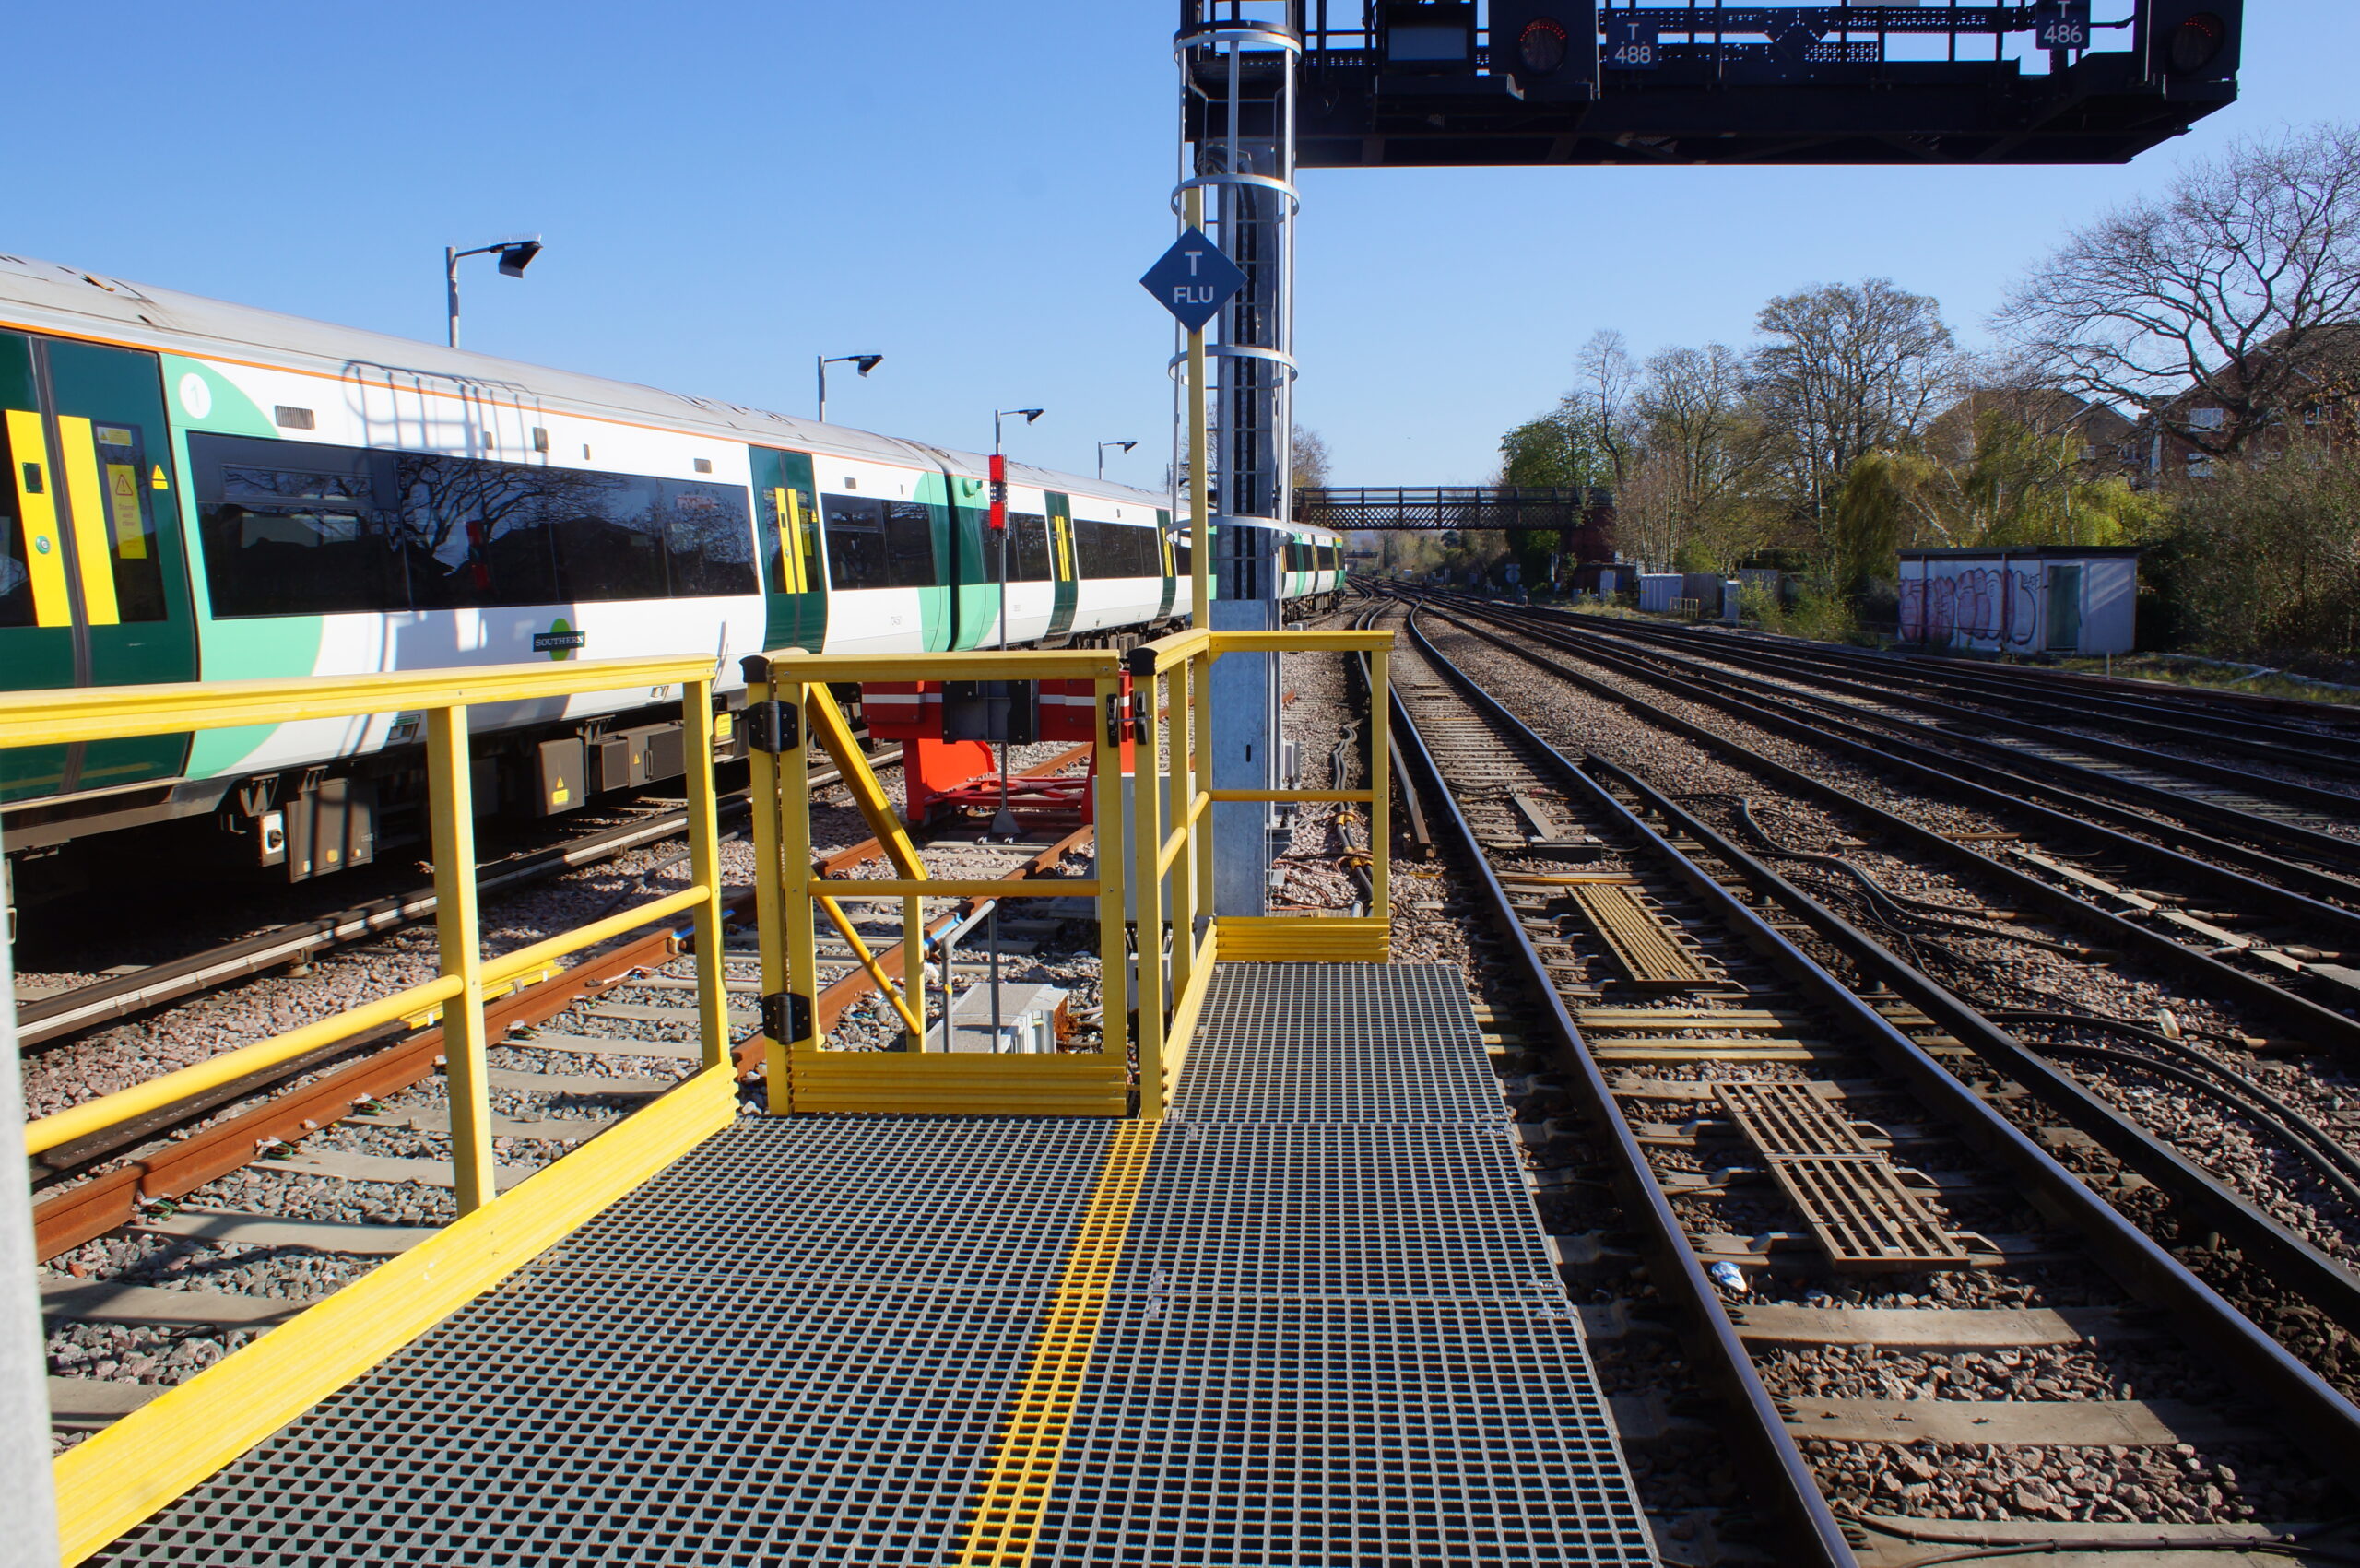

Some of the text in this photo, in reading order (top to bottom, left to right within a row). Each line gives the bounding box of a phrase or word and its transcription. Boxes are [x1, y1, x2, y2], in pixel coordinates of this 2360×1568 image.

[2057, 0, 2071, 18] T
[1627, 23, 1640, 40] T
[2044, 25, 2083, 43] 486
[1614, 45, 1651, 64] 488
[1185, 251, 1203, 276] T
[1174, 286, 1214, 303] FLU
[535, 635, 584, 647] SOUTHERN
